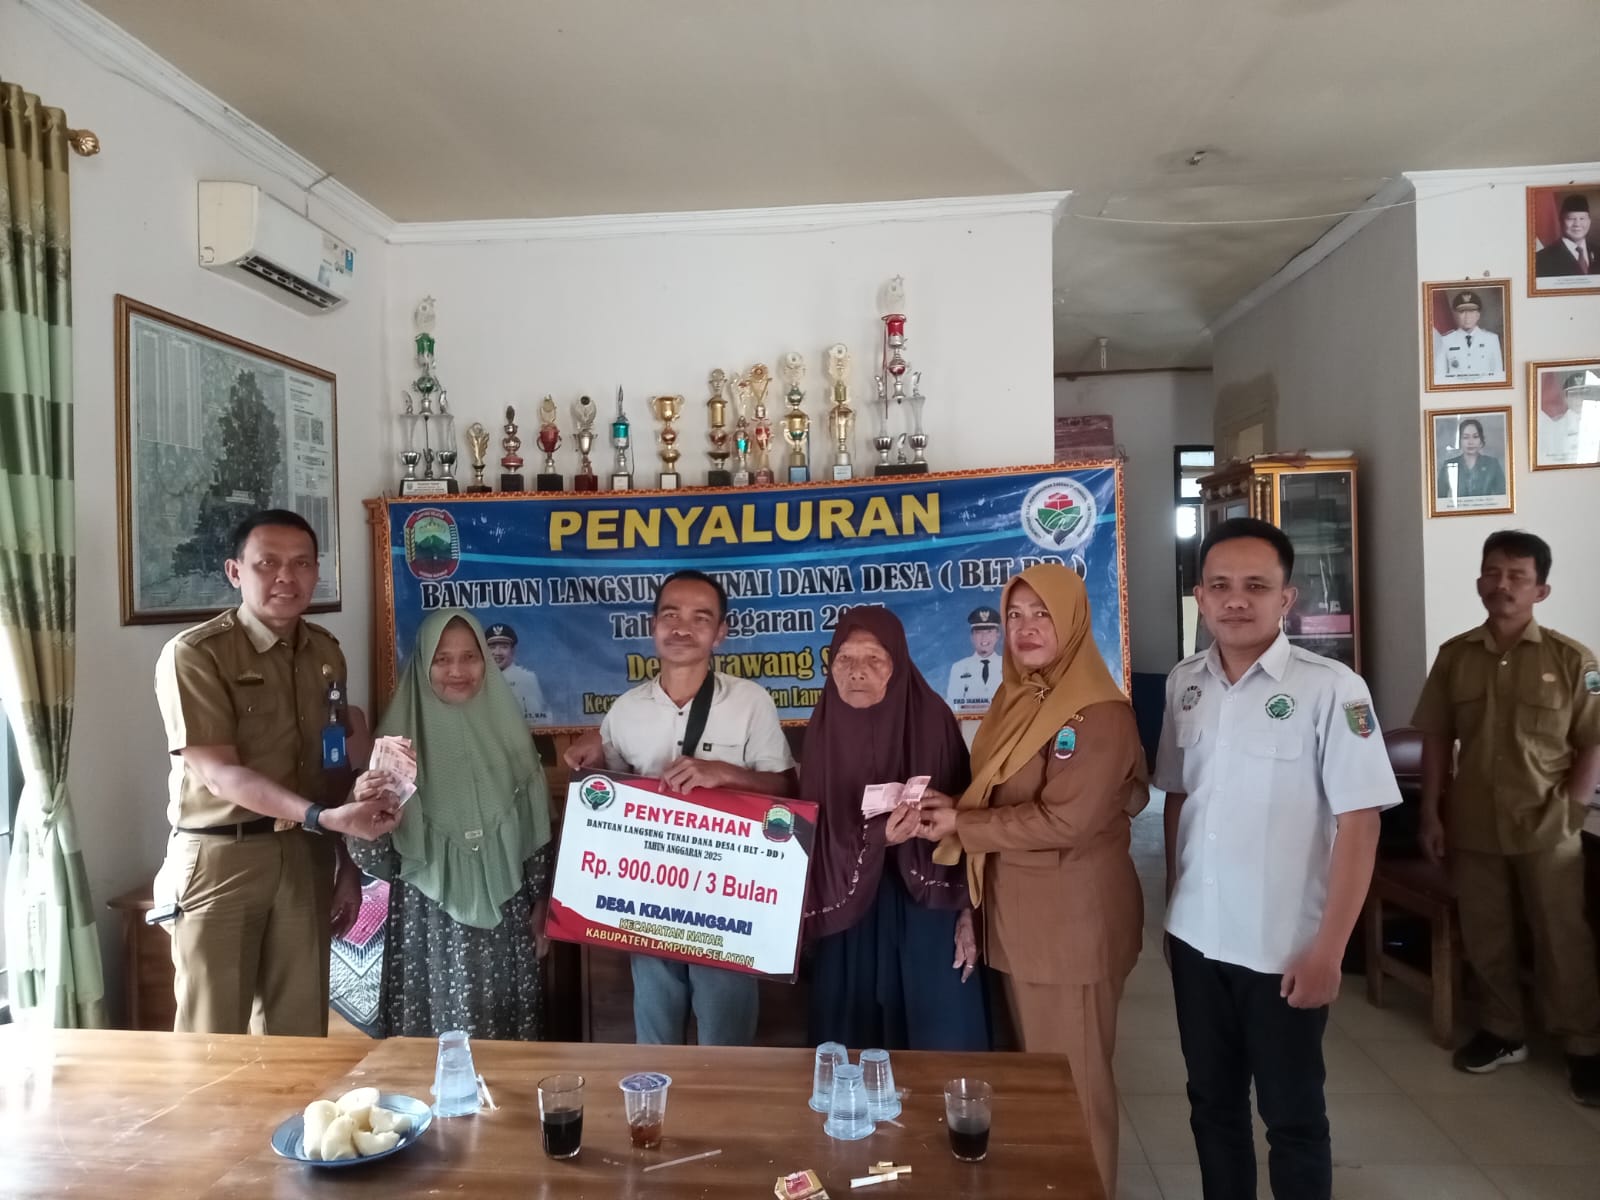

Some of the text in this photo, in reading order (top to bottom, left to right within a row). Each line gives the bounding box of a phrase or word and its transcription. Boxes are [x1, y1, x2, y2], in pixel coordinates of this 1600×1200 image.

[549, 493, 941, 551] PENYALURAN
[421, 578, 542, 610] BANTUAN
[548, 574, 673, 606] LANGSUN
[778, 567, 854, 597] DANA
[861, 562, 934, 594] DESA
[938, 560, 954, 593] (
[959, 557, 1015, 589] BLT
[610, 612, 656, 640] Tah
[724, 608, 815, 639] ggaran
[627, 653, 661, 682] De
[709, 647, 816, 680] rawang
[586, 818, 622, 832] BANTUAN
[624, 825, 664, 839] LANGSUNG
[667, 832, 690, 843] TUNAI
[691, 836, 713, 847] DANA
[715, 840, 735, 851] DESA
[743, 845, 759, 855] BLT
[766, 848, 779, 858] DD
[624, 802, 751, 838] PENYERAHAN
[644, 840, 723, 861] TAHUN ANGGARAN 2025
[581, 851, 778, 905] Rp. 900.000 / 3 Bulan
[595, 895, 753, 936] DESA KRAWANGSARI
[618, 917, 724, 948] KECAMATAN NATAR
[585, 927, 755, 968] KABUPATEN LAMPUNG SELATAN
